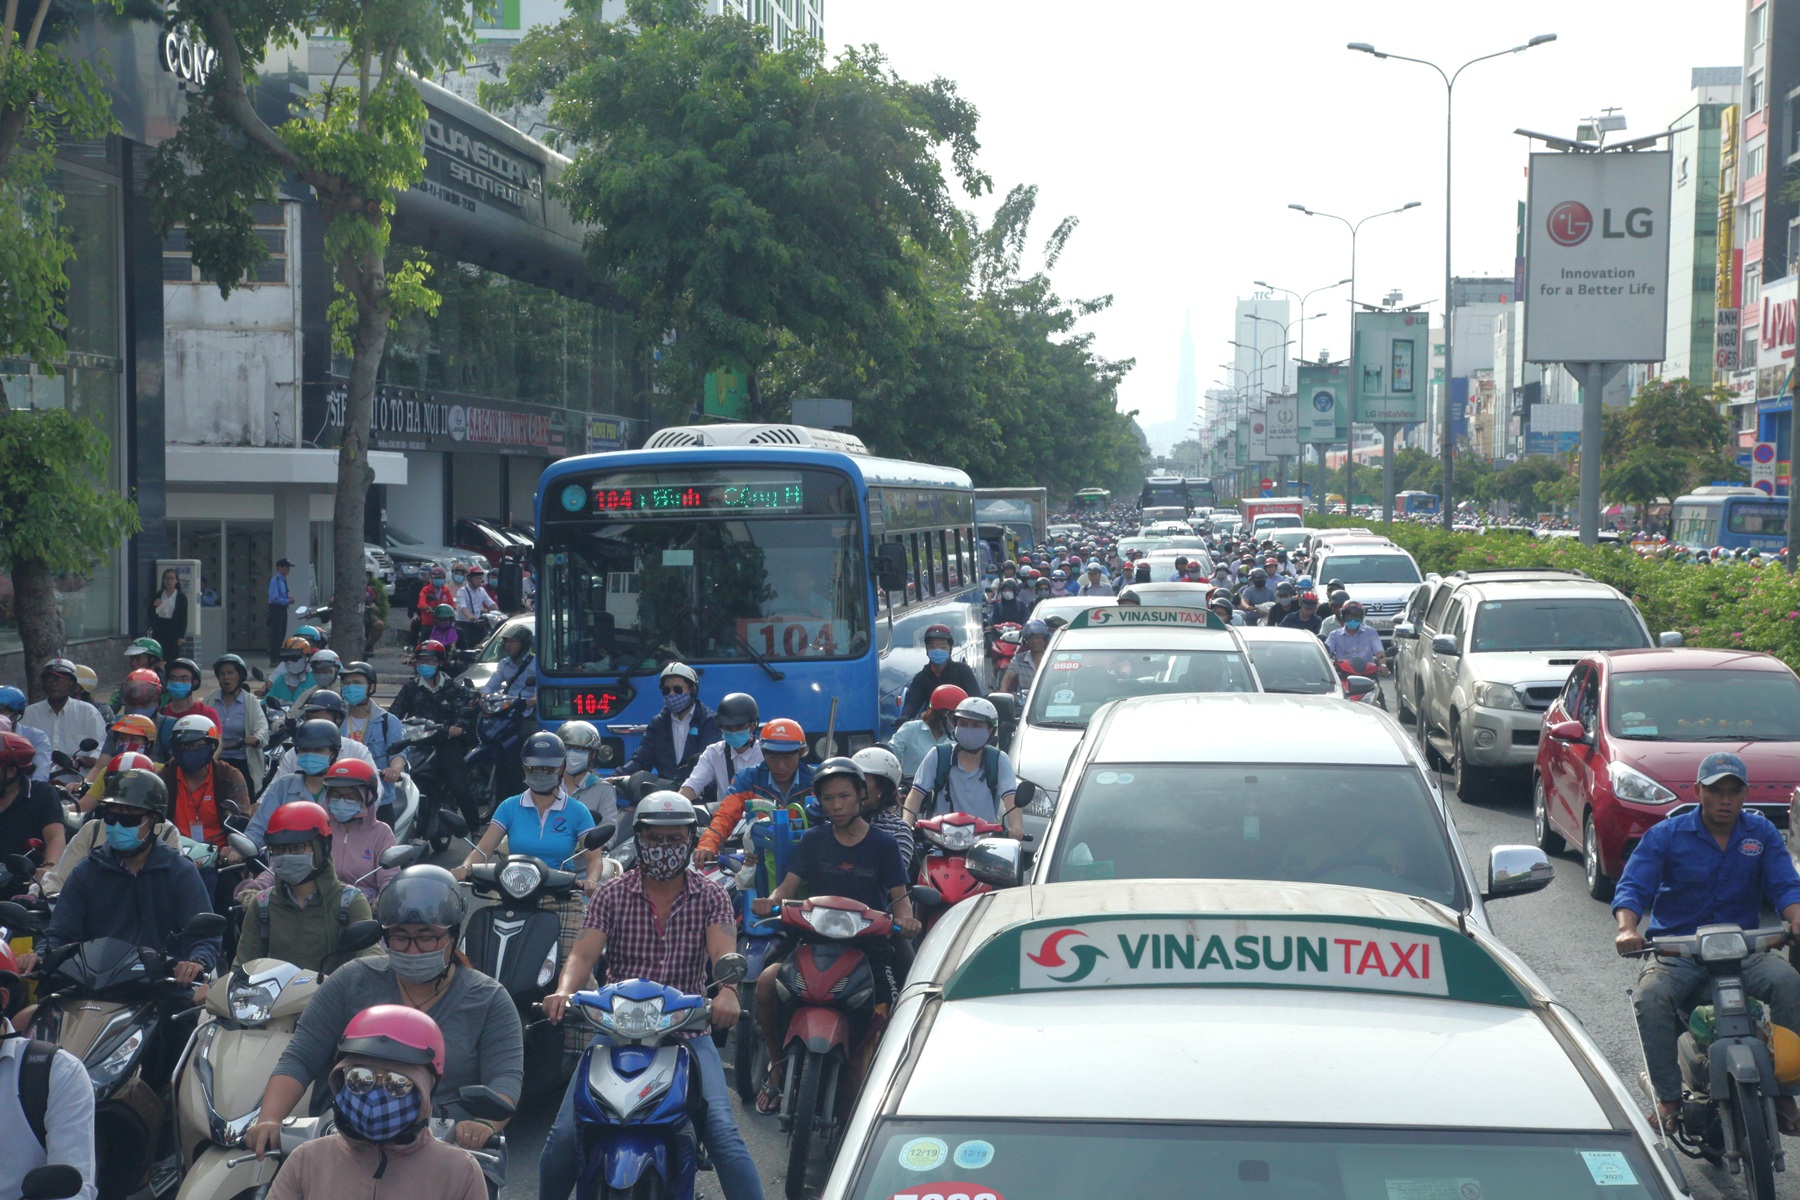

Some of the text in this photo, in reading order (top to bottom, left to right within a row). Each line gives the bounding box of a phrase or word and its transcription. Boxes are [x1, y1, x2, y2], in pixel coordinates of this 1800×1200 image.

[1603, 207, 1653, 239] LG
[1561, 267, 1635, 279] Innovation
[1541, 283, 1656, 296] for a Better Life
[1416, 317, 1428, 325] LG
[1717, 310, 1738, 326] ANH
[1365, 408, 1417, 418] LG InstaView
[595, 489, 633, 511] 104
[1119, 610, 1207, 624] VINASUN TAXI
[759, 622, 839, 660] 104
[573, 692, 617, 715] 104
[1117, 932, 1431, 980] VINASUN TAXI
[910, 1148, 938, 1157] 12/19
[963, 1149, 988, 1158] 12/19
